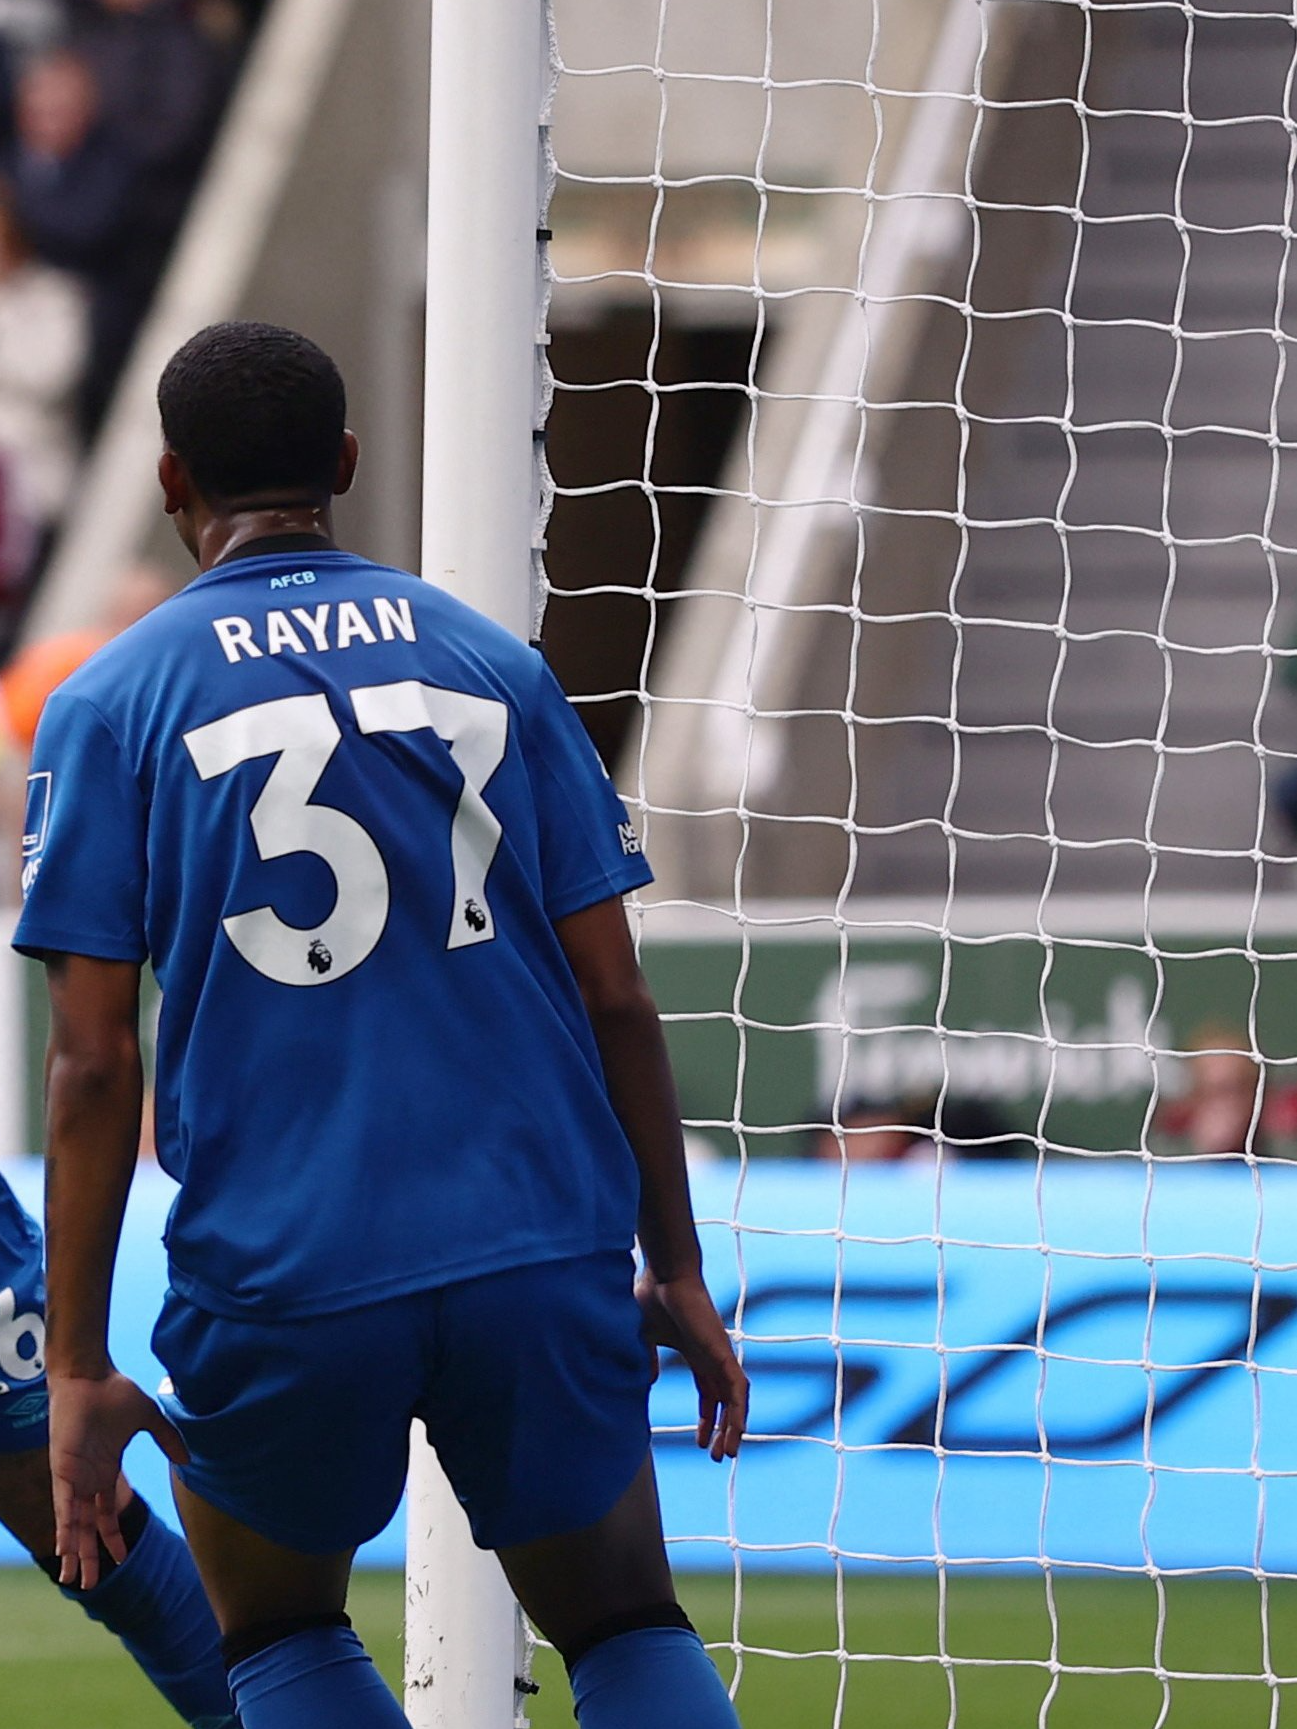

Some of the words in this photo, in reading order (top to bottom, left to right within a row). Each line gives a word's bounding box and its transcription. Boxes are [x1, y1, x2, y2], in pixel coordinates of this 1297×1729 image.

[270, 571, 316, 590] AFCB
[212, 597, 418, 663] RAYAN
[182, 680, 508, 987] 37
